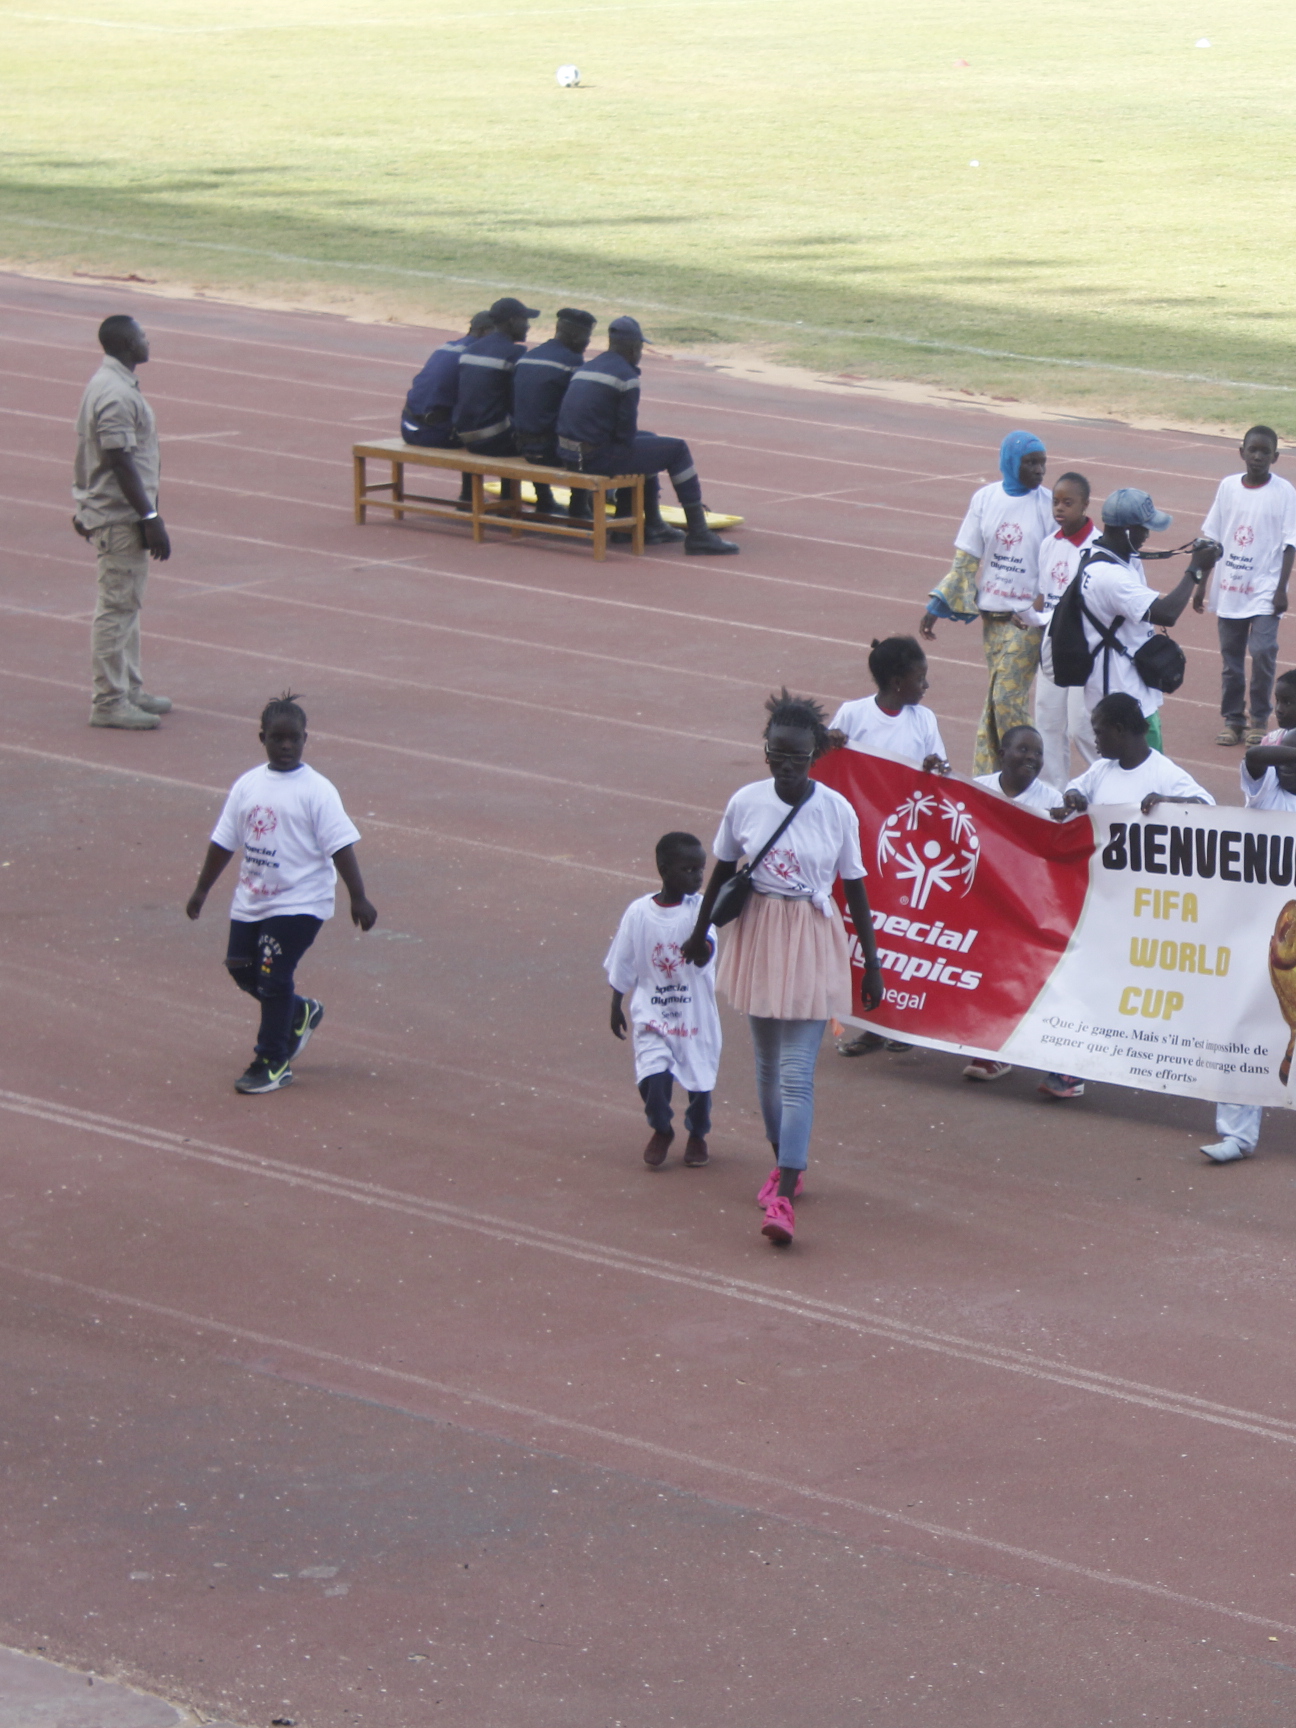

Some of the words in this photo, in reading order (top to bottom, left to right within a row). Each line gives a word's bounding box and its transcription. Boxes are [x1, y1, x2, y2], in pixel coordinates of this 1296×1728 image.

[1133, 887, 1199, 923] FIFA
[1129, 936, 1232, 978] WORLD
[1118, 986, 1185, 1021] CUP
[1040, 1033, 1084, 1049] gagner
[1086, 1042, 1110, 1054] que
[1111, 1045, 1124, 1057] je
[1125, 1047, 1154, 1061] fasse
[1156, 1053, 1194, 1067] preuve
[1195, 1056, 1205, 1068] de
[1239, 1062, 1270, 1075] dans
[1076, 1020, 1090, 1033] je
[1091, 1025, 1129, 1040] gagne.
[1131, 1029, 1160, 1043] Mais
[1205, 1039, 1251, 1055] impossible
[1253, 1045, 1269, 1056] de
[1129, 1065, 1153, 1078] mes
